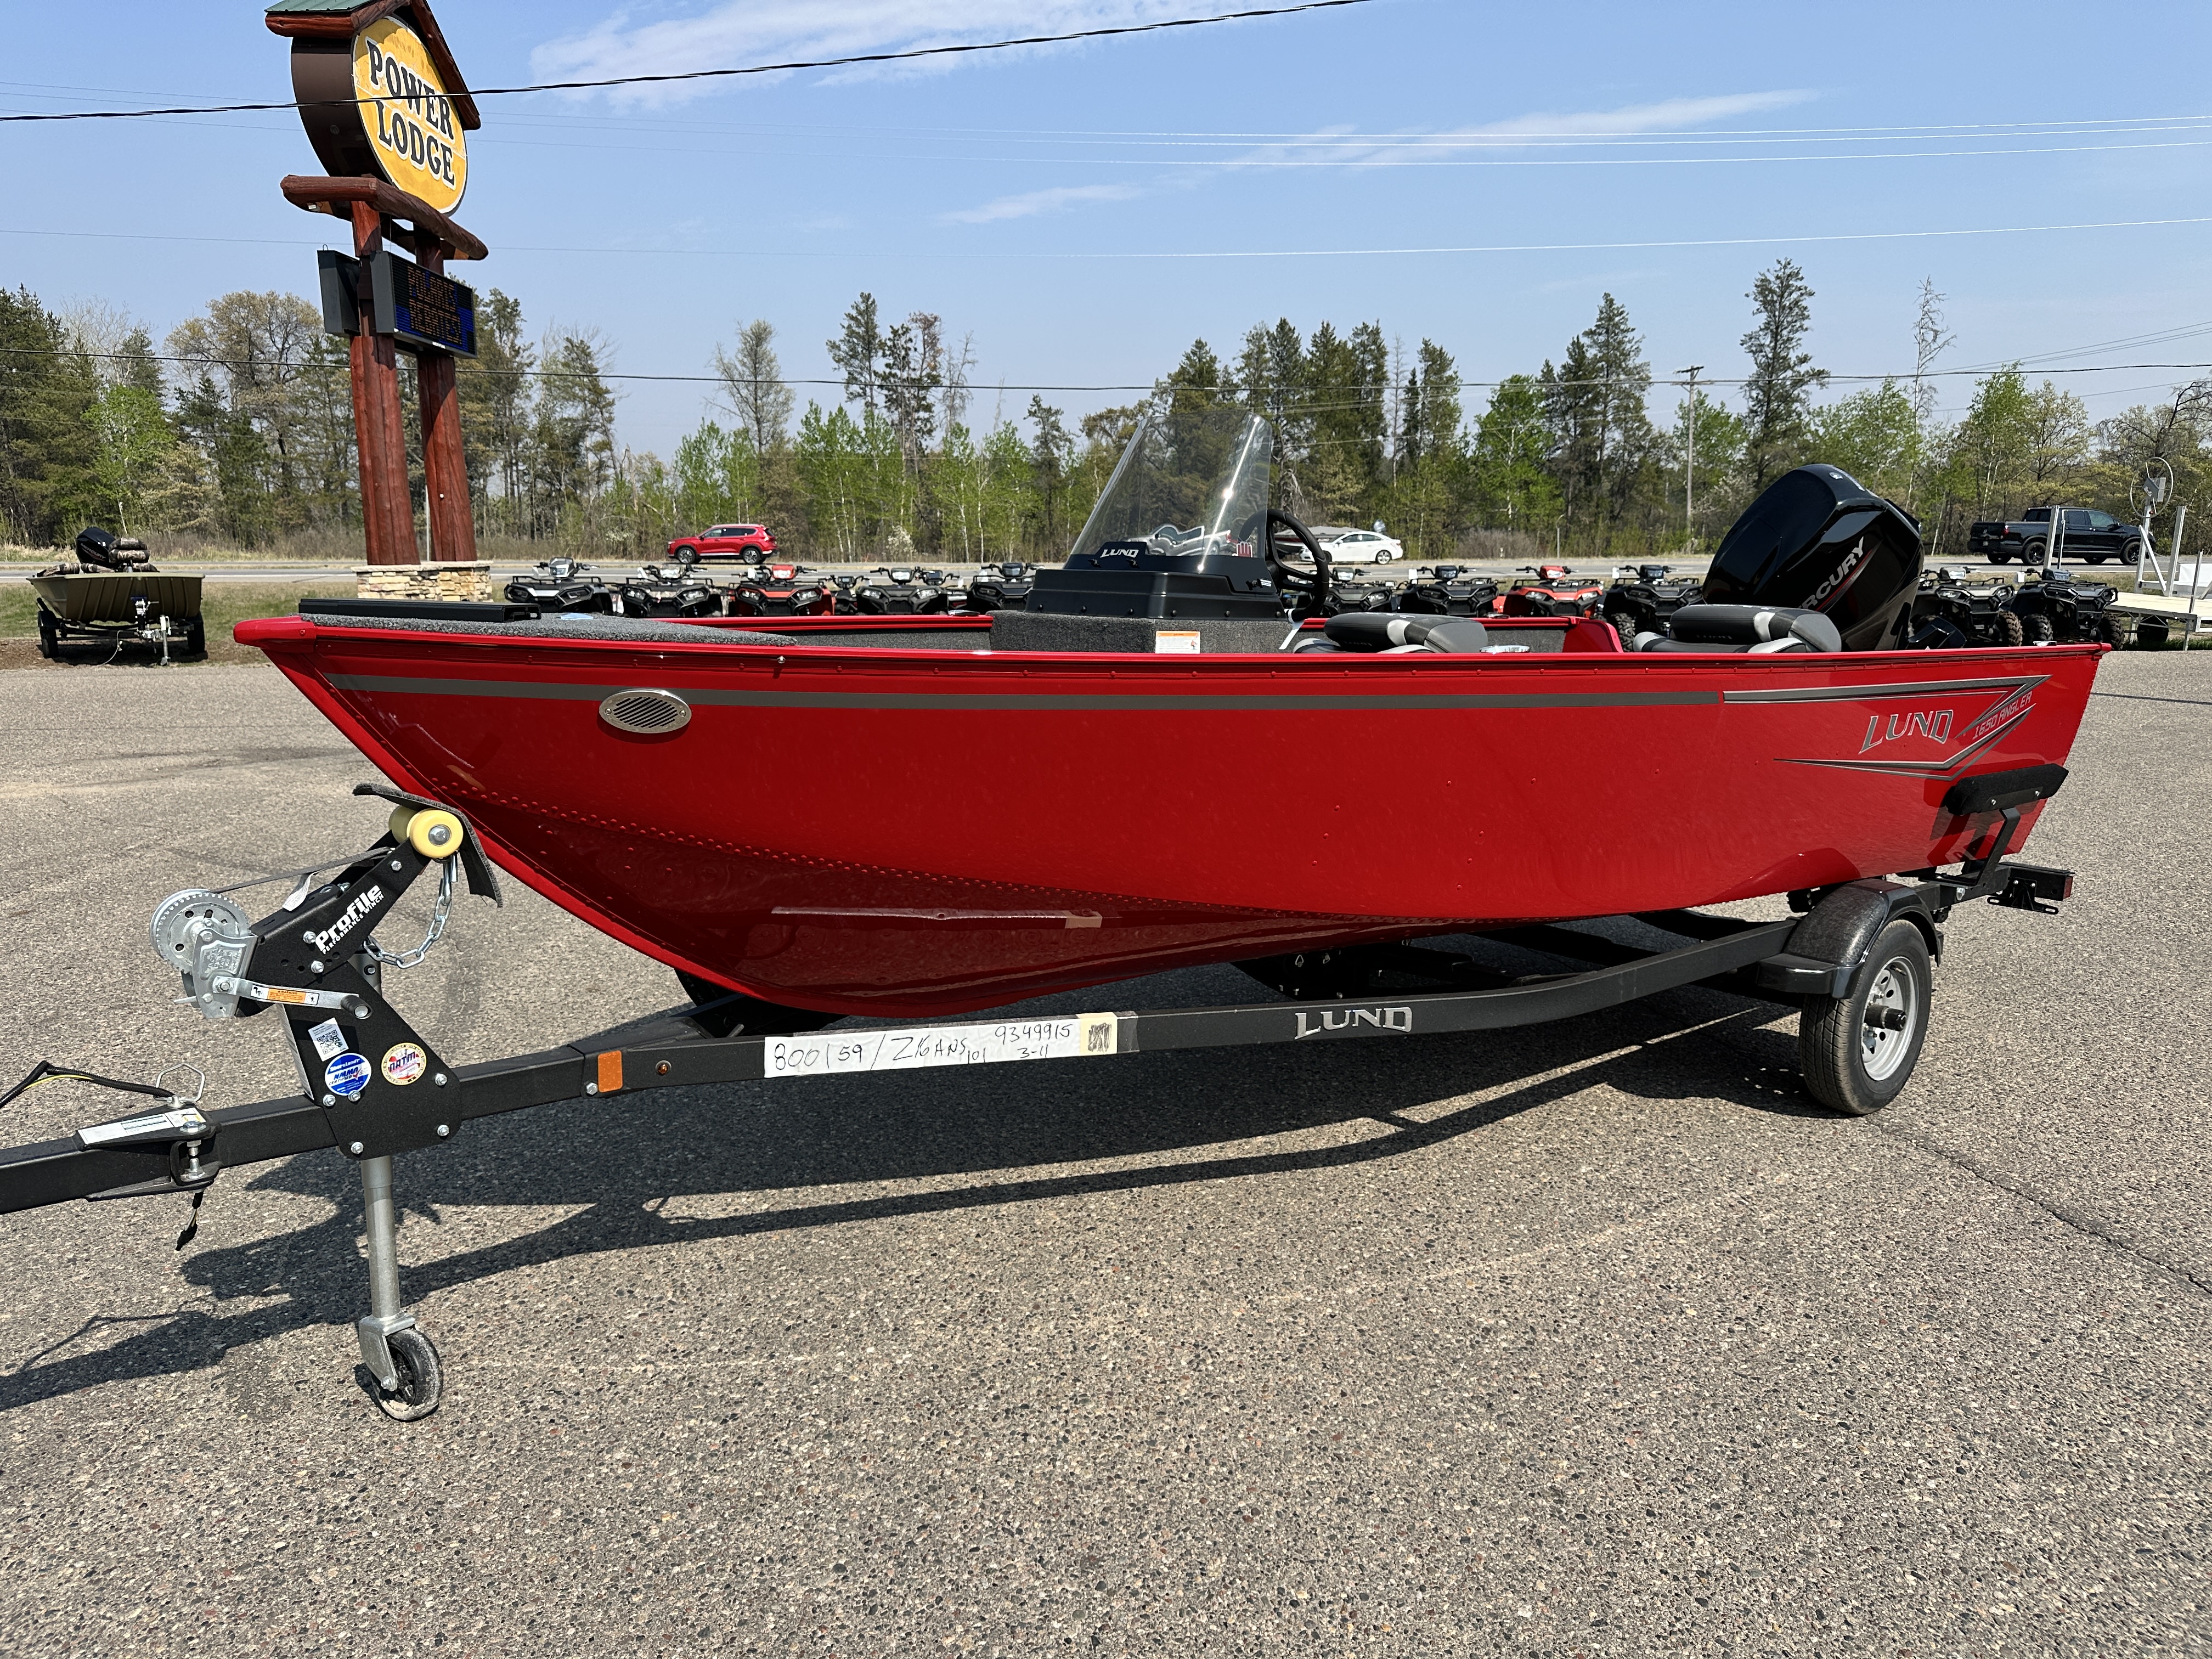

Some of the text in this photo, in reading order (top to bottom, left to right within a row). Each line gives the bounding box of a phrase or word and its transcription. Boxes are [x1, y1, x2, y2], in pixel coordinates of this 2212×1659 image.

[367, 40, 454, 140] POWER
[376, 100, 455, 186] LODGE
[407, 265, 456, 314] POLARIS
[1099, 549, 1139, 558] LUND
[1798, 536, 1864, 610] RCURY
[1997, 690, 2033, 726] ANGLER
[1858, 709, 1954, 755] LUND
[314, 885, 382, 950] Profile
[321, 893, 385, 955] PERFORMANCE WINCH
[995, 1023, 1073, 1045] 9349915
[1294, 1007, 1413, 1040] LUND
[333, 1066, 359, 1080] NMMA
